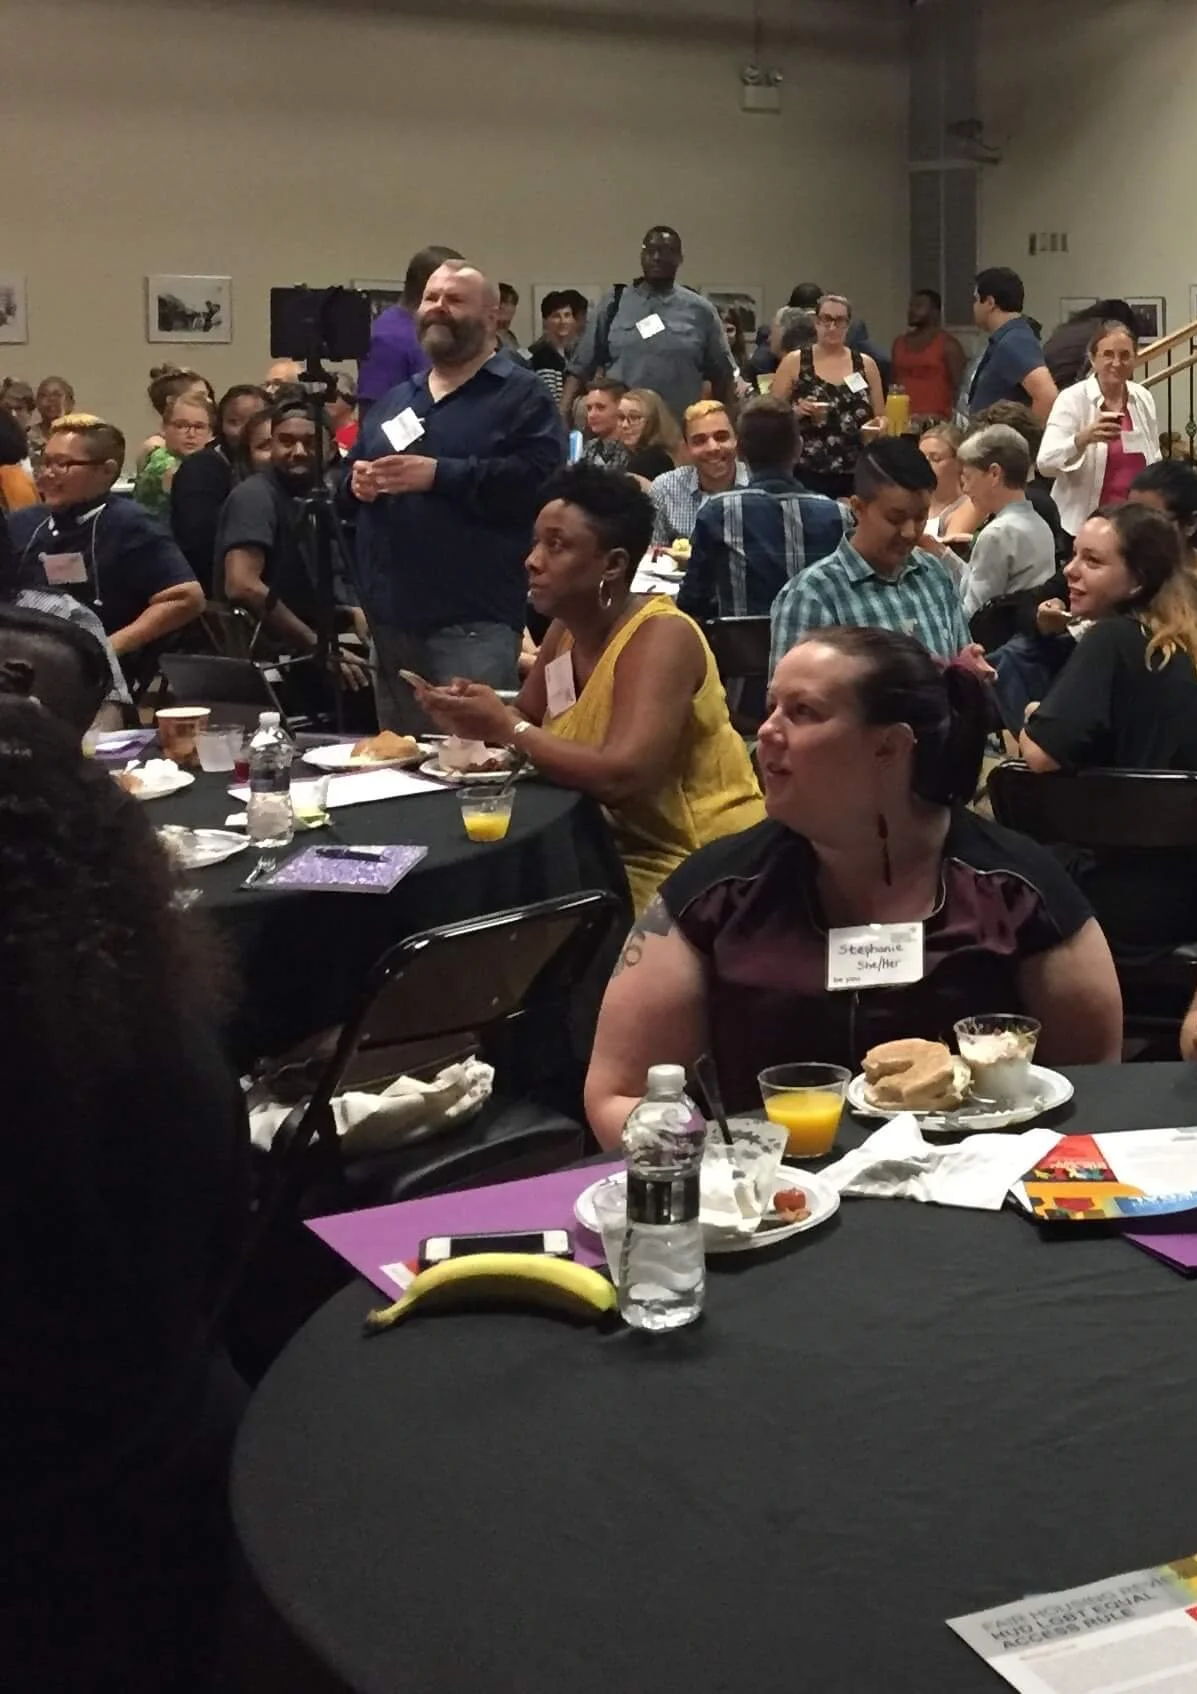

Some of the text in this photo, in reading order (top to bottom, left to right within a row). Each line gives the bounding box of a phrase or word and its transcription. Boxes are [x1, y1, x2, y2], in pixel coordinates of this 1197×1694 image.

[838, 944, 904, 958] Stephanie
[991, 1592, 1157, 1640] HUD LGBT EQUAL
[1003, 1608, 1136, 1649] ACCESS RULE
